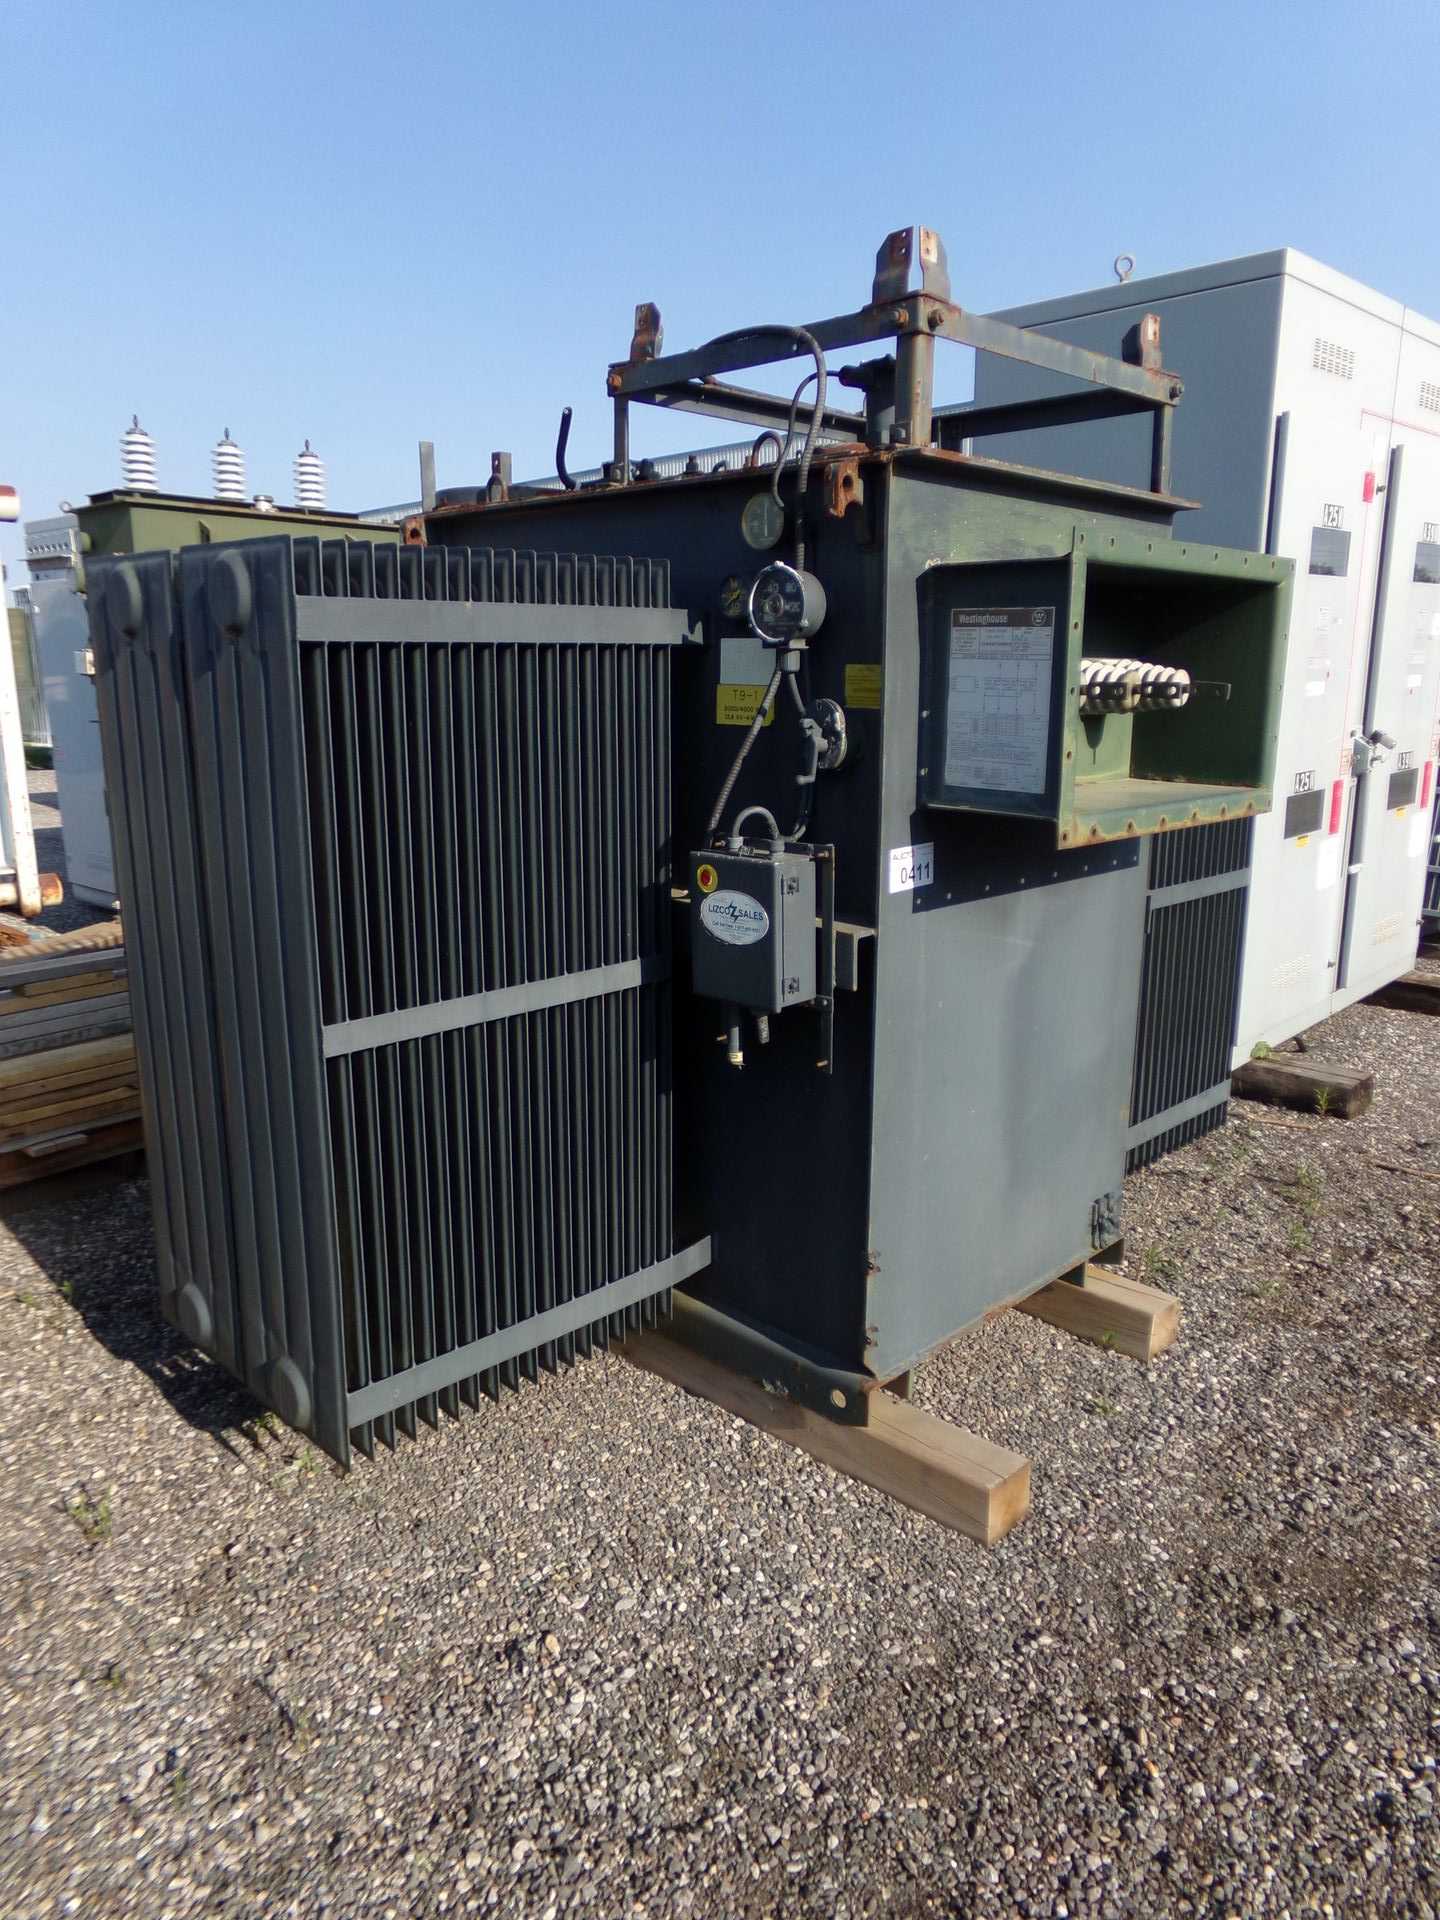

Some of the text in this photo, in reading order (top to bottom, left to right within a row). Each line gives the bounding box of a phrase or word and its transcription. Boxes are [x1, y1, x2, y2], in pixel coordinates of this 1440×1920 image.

[959, 614, 1009, 625] Westinghouse
[900, 860, 930, 885] 0411
[708, 902, 764, 922] LIZCO SALES
